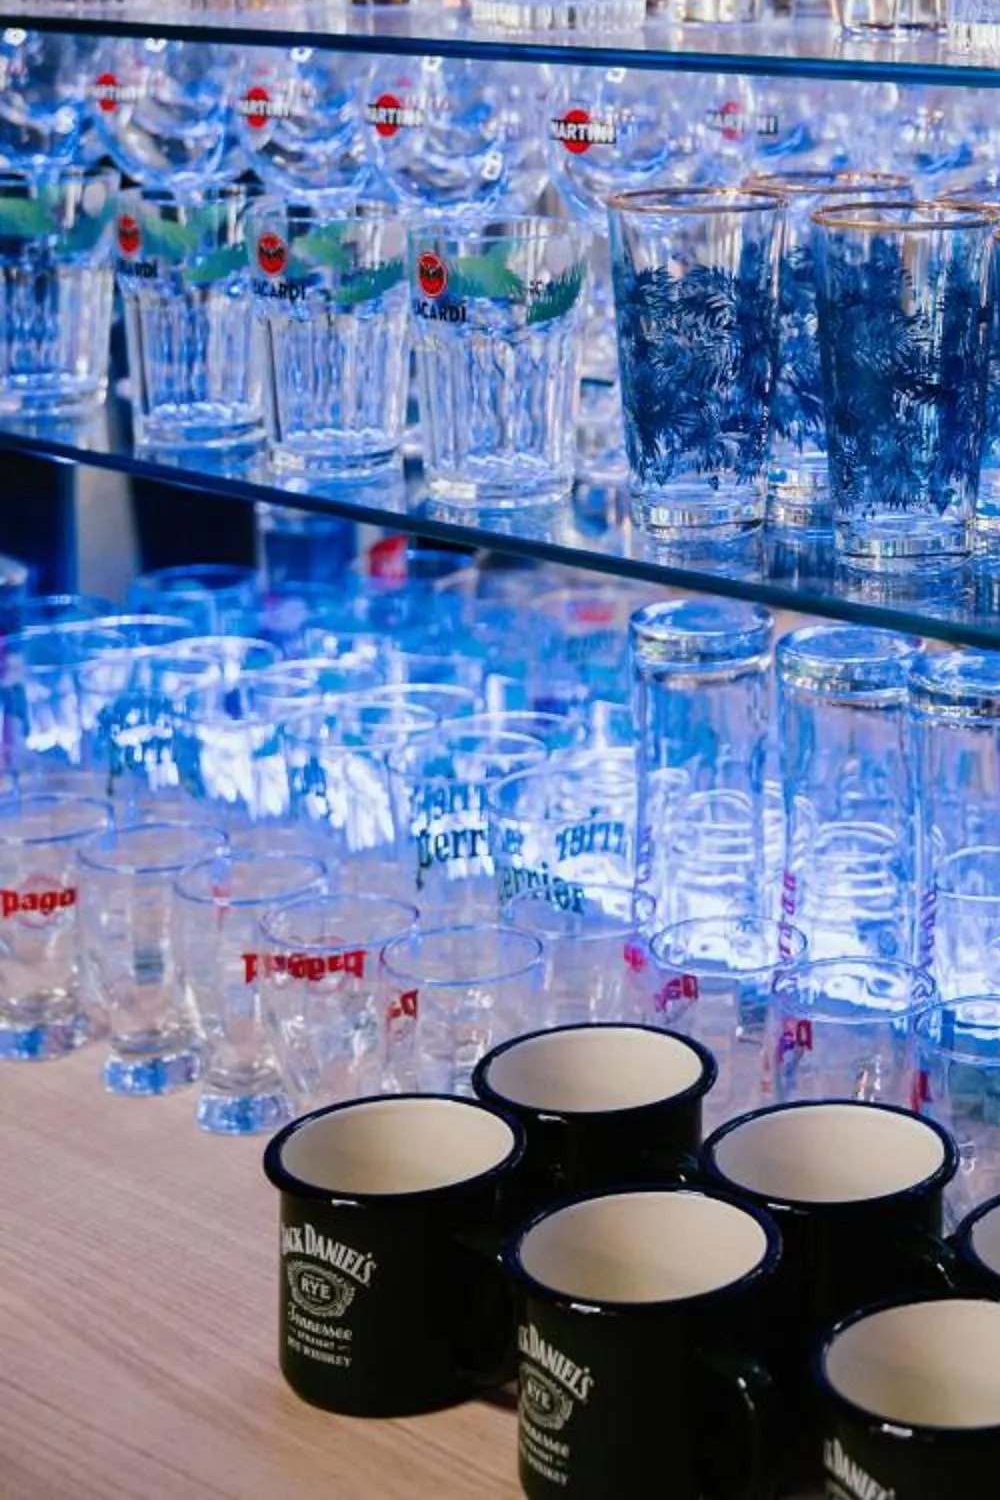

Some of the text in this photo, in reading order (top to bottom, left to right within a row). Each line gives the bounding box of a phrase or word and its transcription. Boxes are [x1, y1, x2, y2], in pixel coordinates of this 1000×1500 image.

[0, 887, 77, 919] pago
[304, 1223, 377, 1287] DANIEL'S
[301, 1274, 331, 1301] RYE
